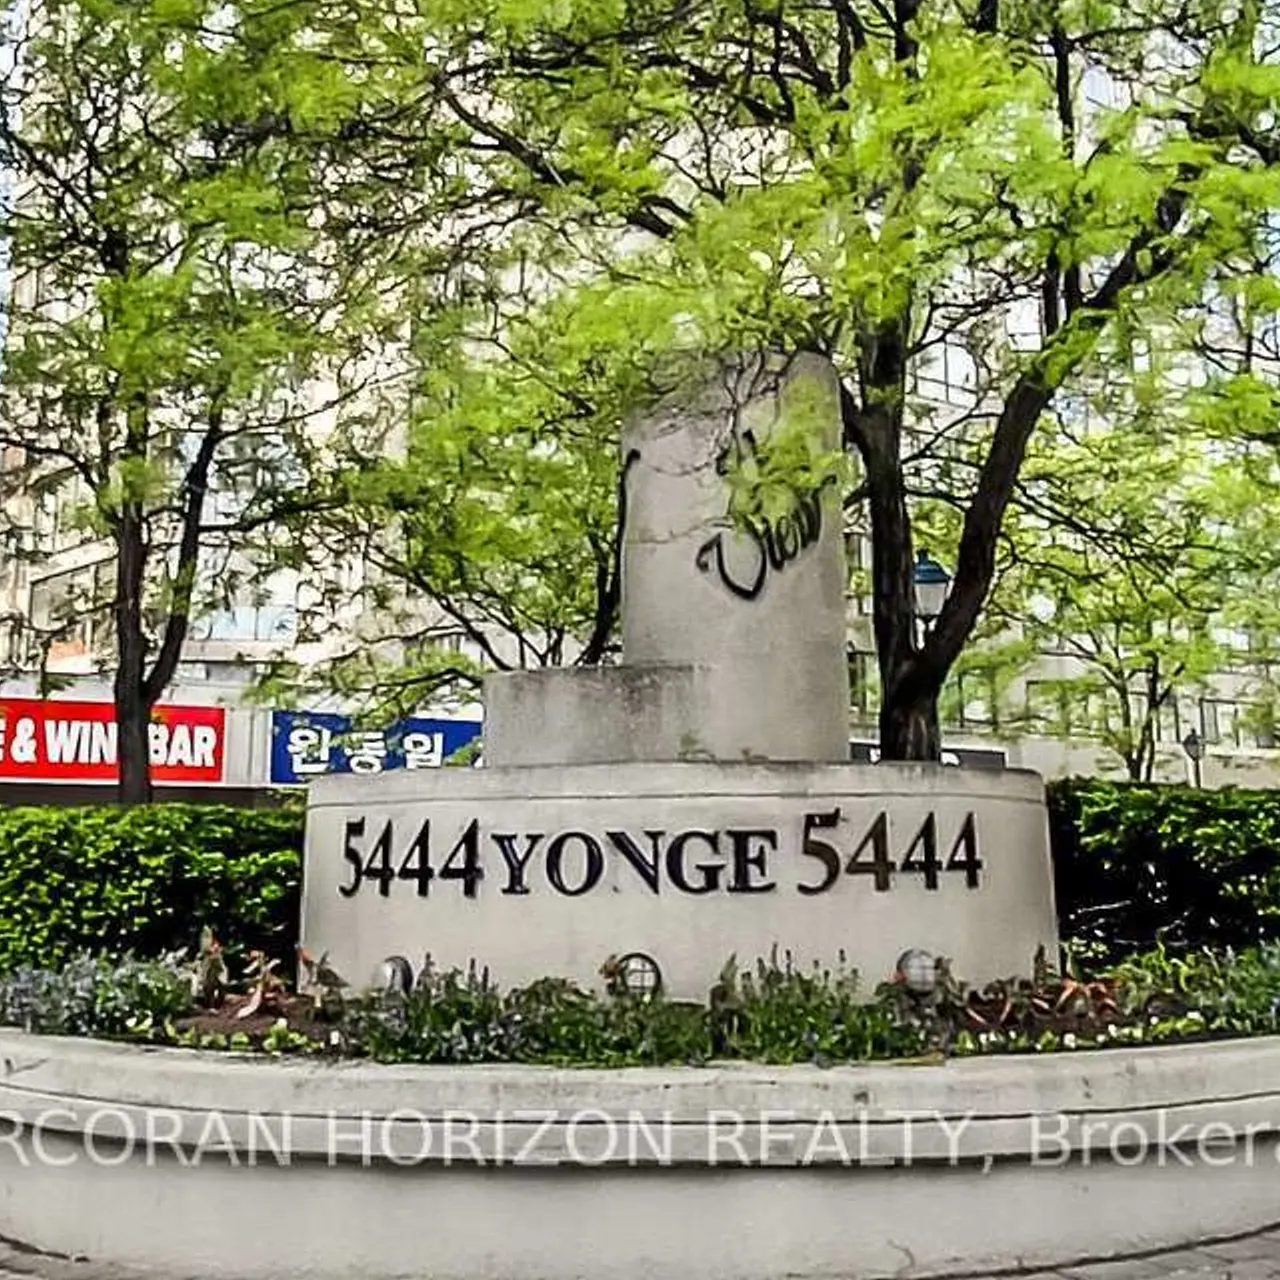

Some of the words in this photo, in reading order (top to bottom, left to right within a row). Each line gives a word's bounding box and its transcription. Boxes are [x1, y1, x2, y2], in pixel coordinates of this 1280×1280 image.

[10, 717, 37, 764] &
[44, 719, 120, 765] WIN
[147, 722, 217, 767] BAR
[338, 815, 485, 898] 5444
[490, 828, 777, 897] YONGE
[796, 807, 983, 896] 5444
